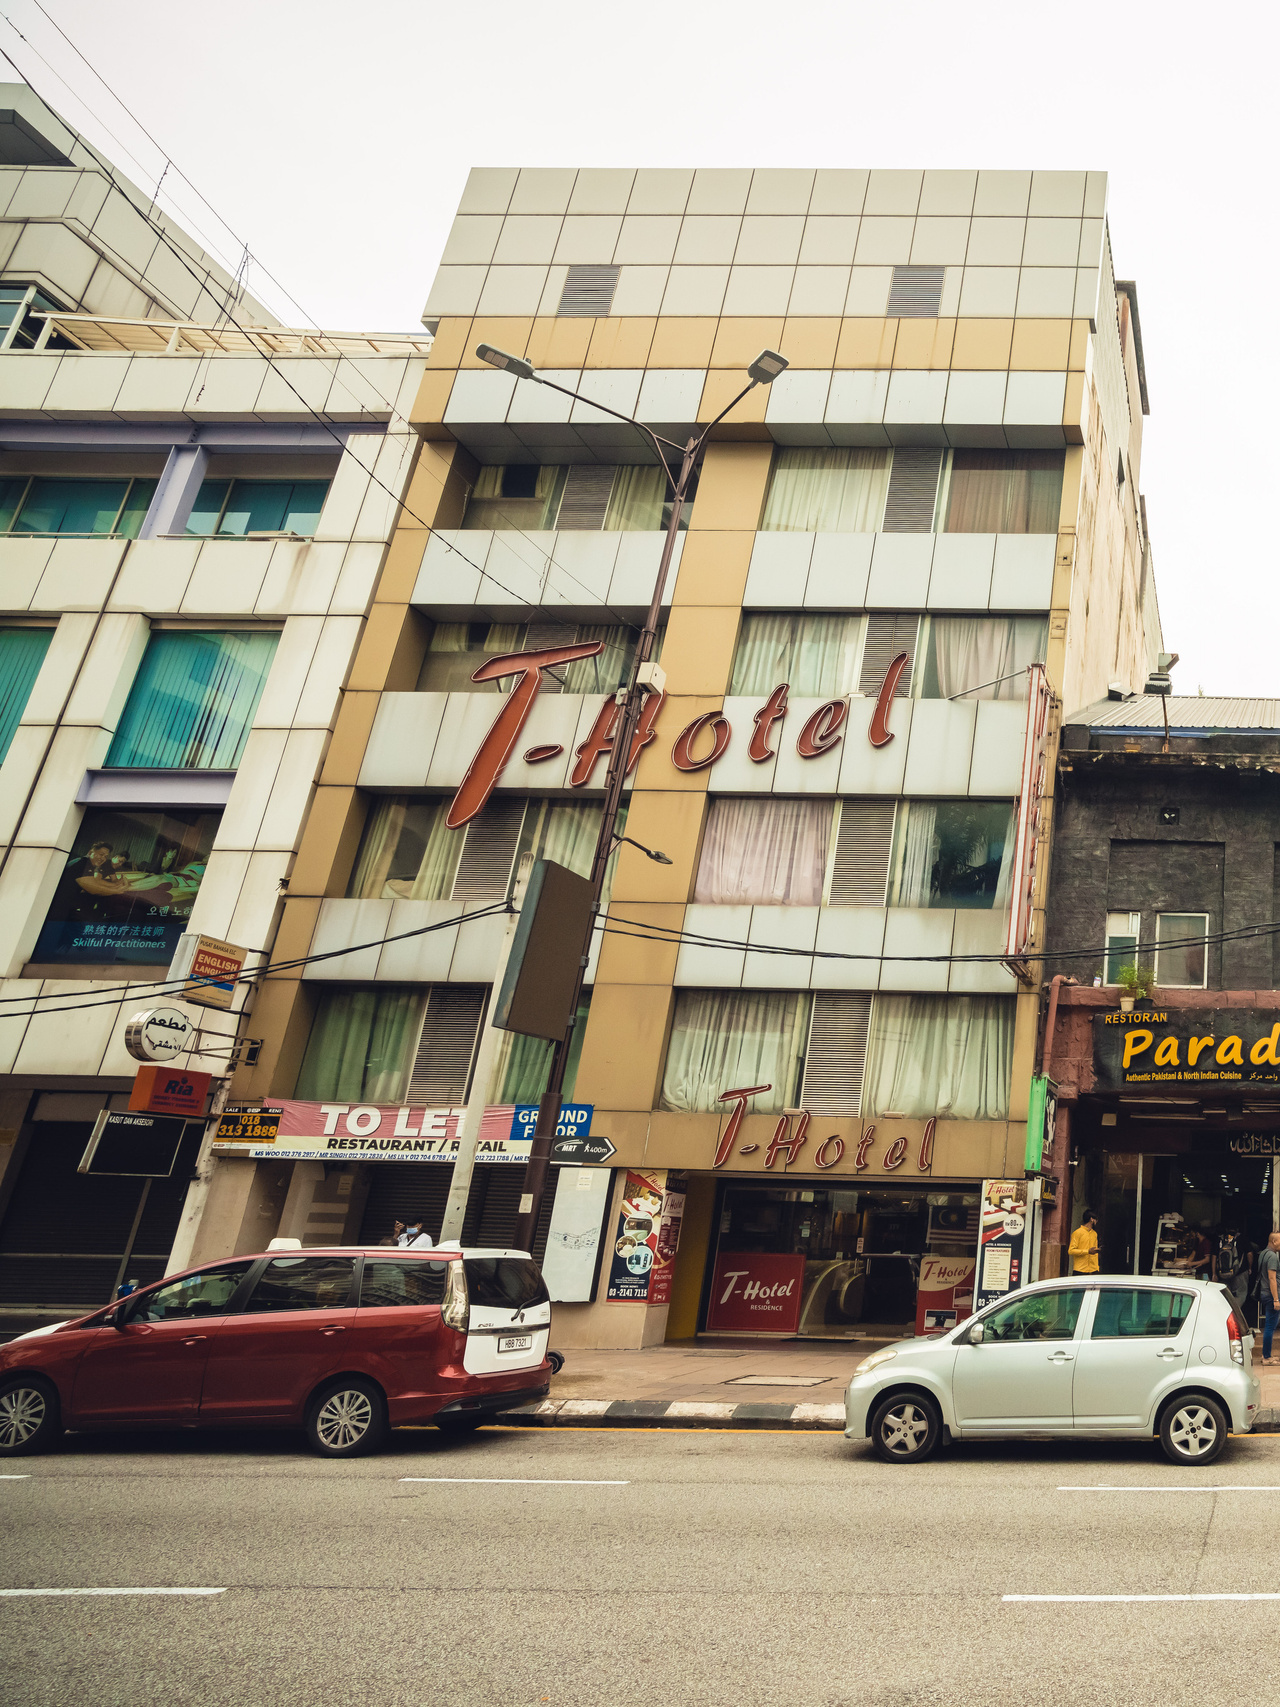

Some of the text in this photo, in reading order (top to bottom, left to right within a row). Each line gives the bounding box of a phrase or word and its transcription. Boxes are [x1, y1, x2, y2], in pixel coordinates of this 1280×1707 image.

[445, 640, 909, 829] T-Hotel
[72, 937, 166, 949] Skilful Practitioners
[198, 953, 238, 971] ENGLISH
[145, 1017, 187, 1032] مطعم
[1105, 1013, 1168, 1025] RESTORAN
[1126, 1071, 1242, 1081] Authentic Pakistani & North Indian Cuisine
[164, 1076, 194, 1096] Ria
[108, 1115, 124, 1123] KASUT
[124, 1116, 133, 1124] DAN
[241, 1115, 261, 1125] 018
[320, 1104, 468, 1138] TO LET
[218, 1124, 278, 1137] 313 1888
[713, 1084, 937, 1171] T-Hotel
[327, 1138, 437, 1152] RESTAURANT
[438, 1140, 449, 1153] /
[562, 1144, 578, 1152] MRT
[923, 1260, 968, 1282] T-Hotel
[608, 1288, 616, 1296] 03
[634, 1288, 648, 1297] 7115
[720, 1270, 795, 1305] T-Hotel
[505, 1338, 527, 1349] HBB 7321
